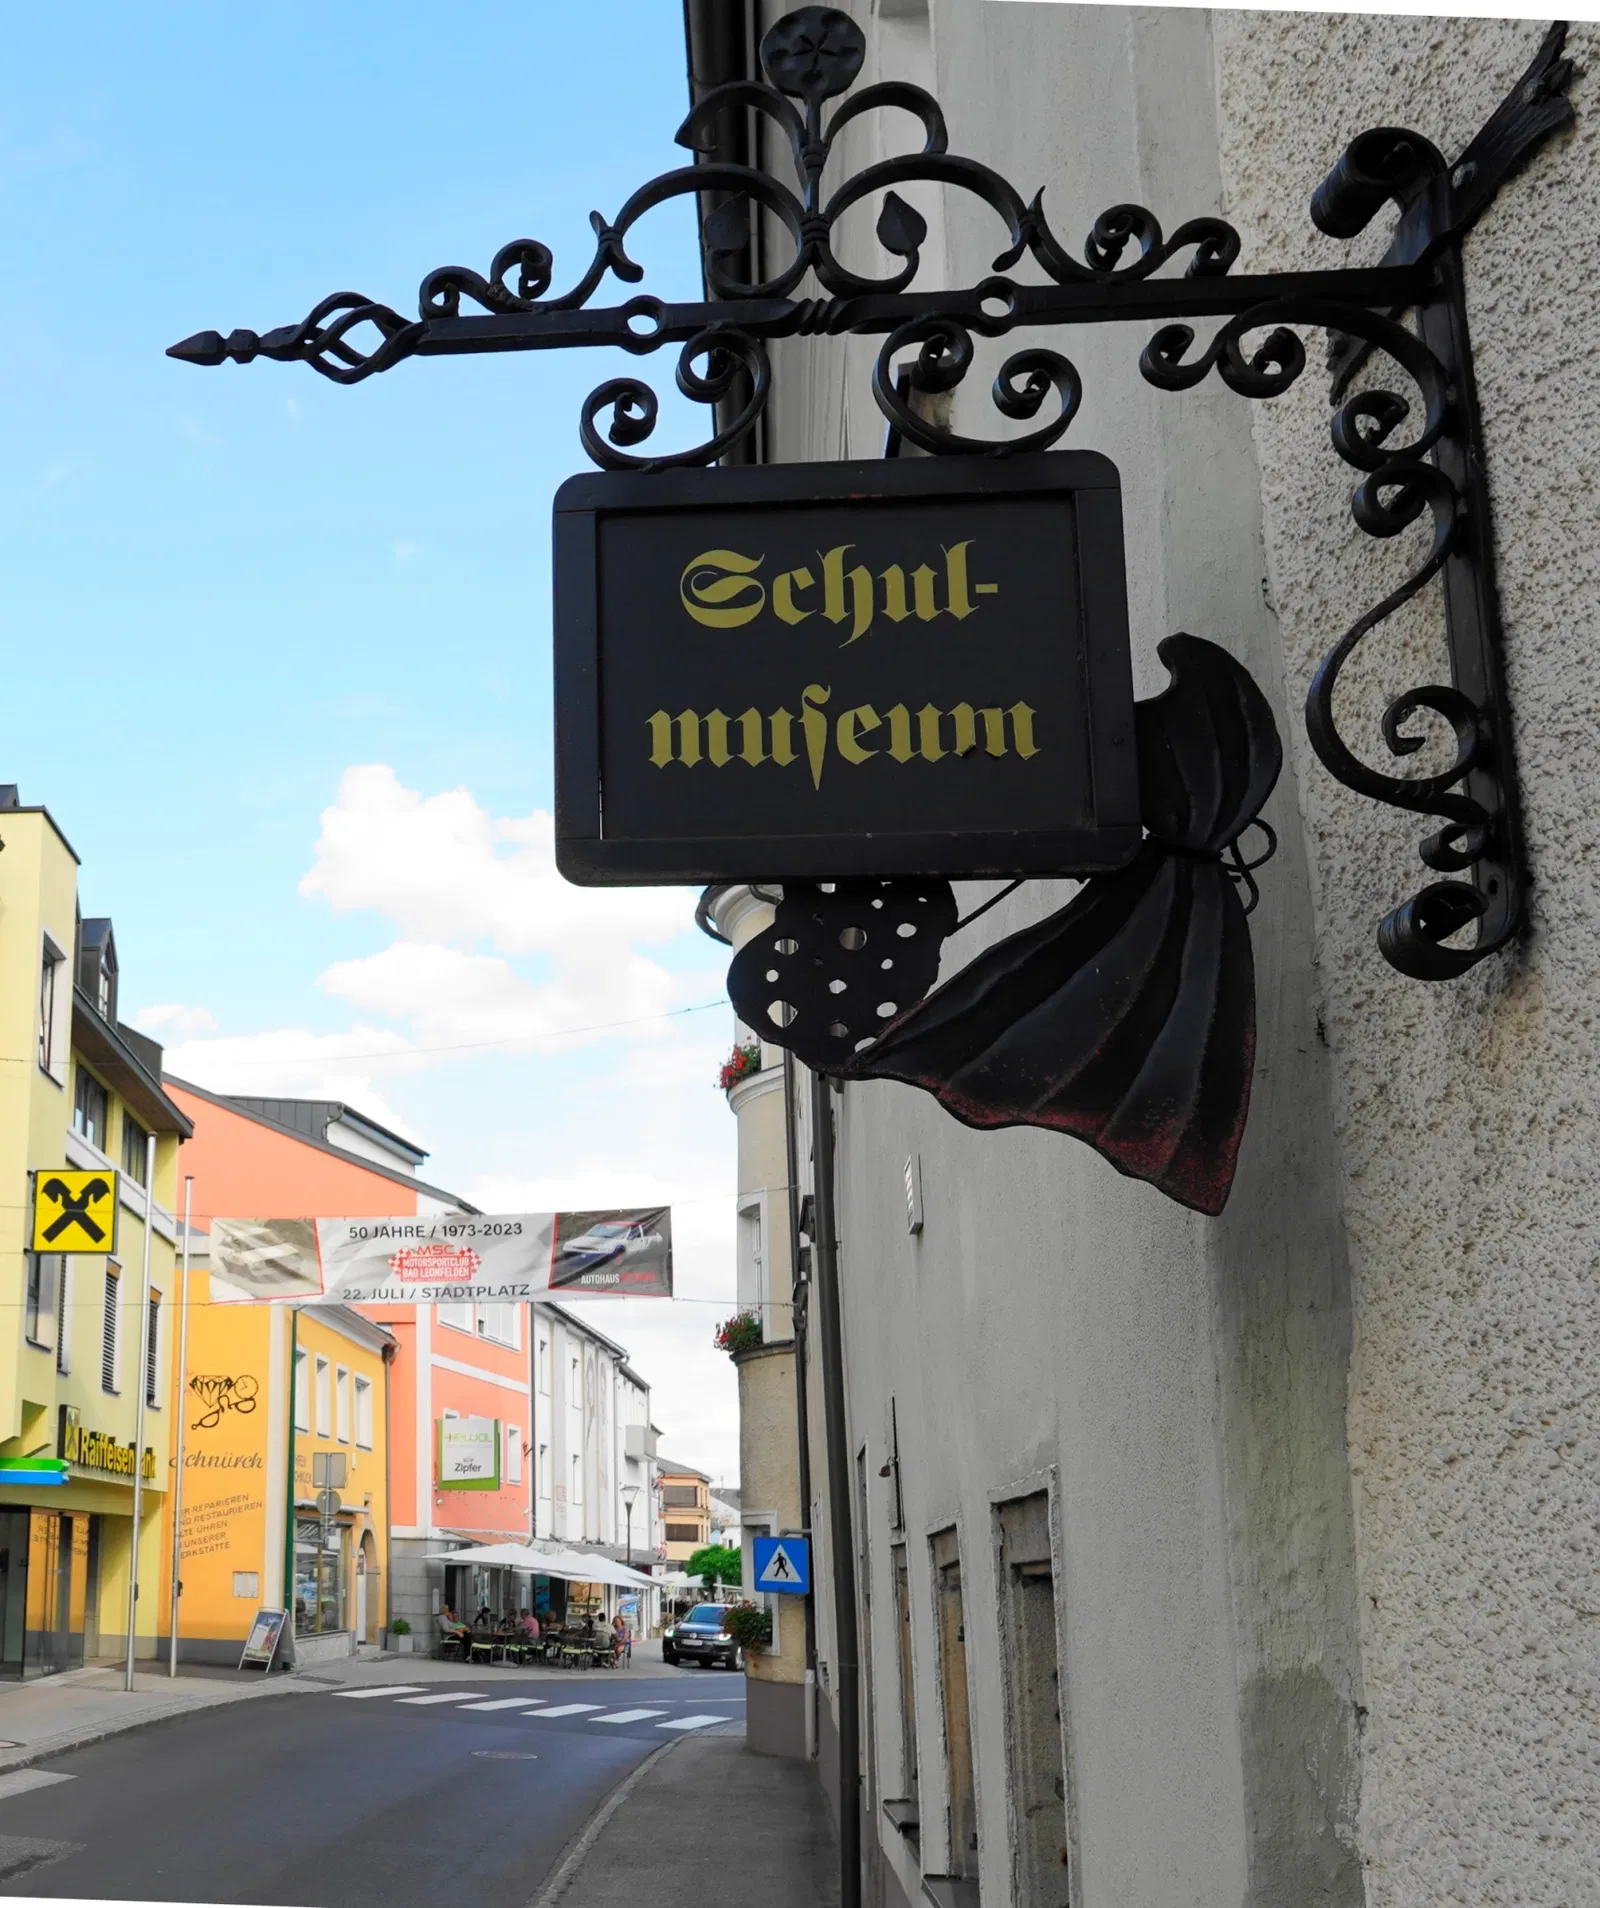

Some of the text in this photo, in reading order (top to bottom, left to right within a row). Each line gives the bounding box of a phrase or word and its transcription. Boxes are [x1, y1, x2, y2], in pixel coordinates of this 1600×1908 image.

[680, 539, 999, 649] Schul-
[349, 1222, 523, 1239] 50 JAHRE / 1973-2023
[416, 1244, 456, 1256] MSC
[402, 1267, 470, 1278] BAD LEONFELDEN
[580, 1273, 620, 1285] AUTOHAUS
[342, 1284, 531, 1301] 22. JULI / STADTPLATZ
[454, 1462, 482, 1475] Zipfer
[192, 1492, 250, 1513] REPARIEREN
[193, 1501, 263, 1523] RESTAURIEREN
[196, 1520, 228, 1534] UHREN
[183, 1532, 226, 1549] UNSERER
[179, 1541, 231, 1560] ERKSTÄTTE
